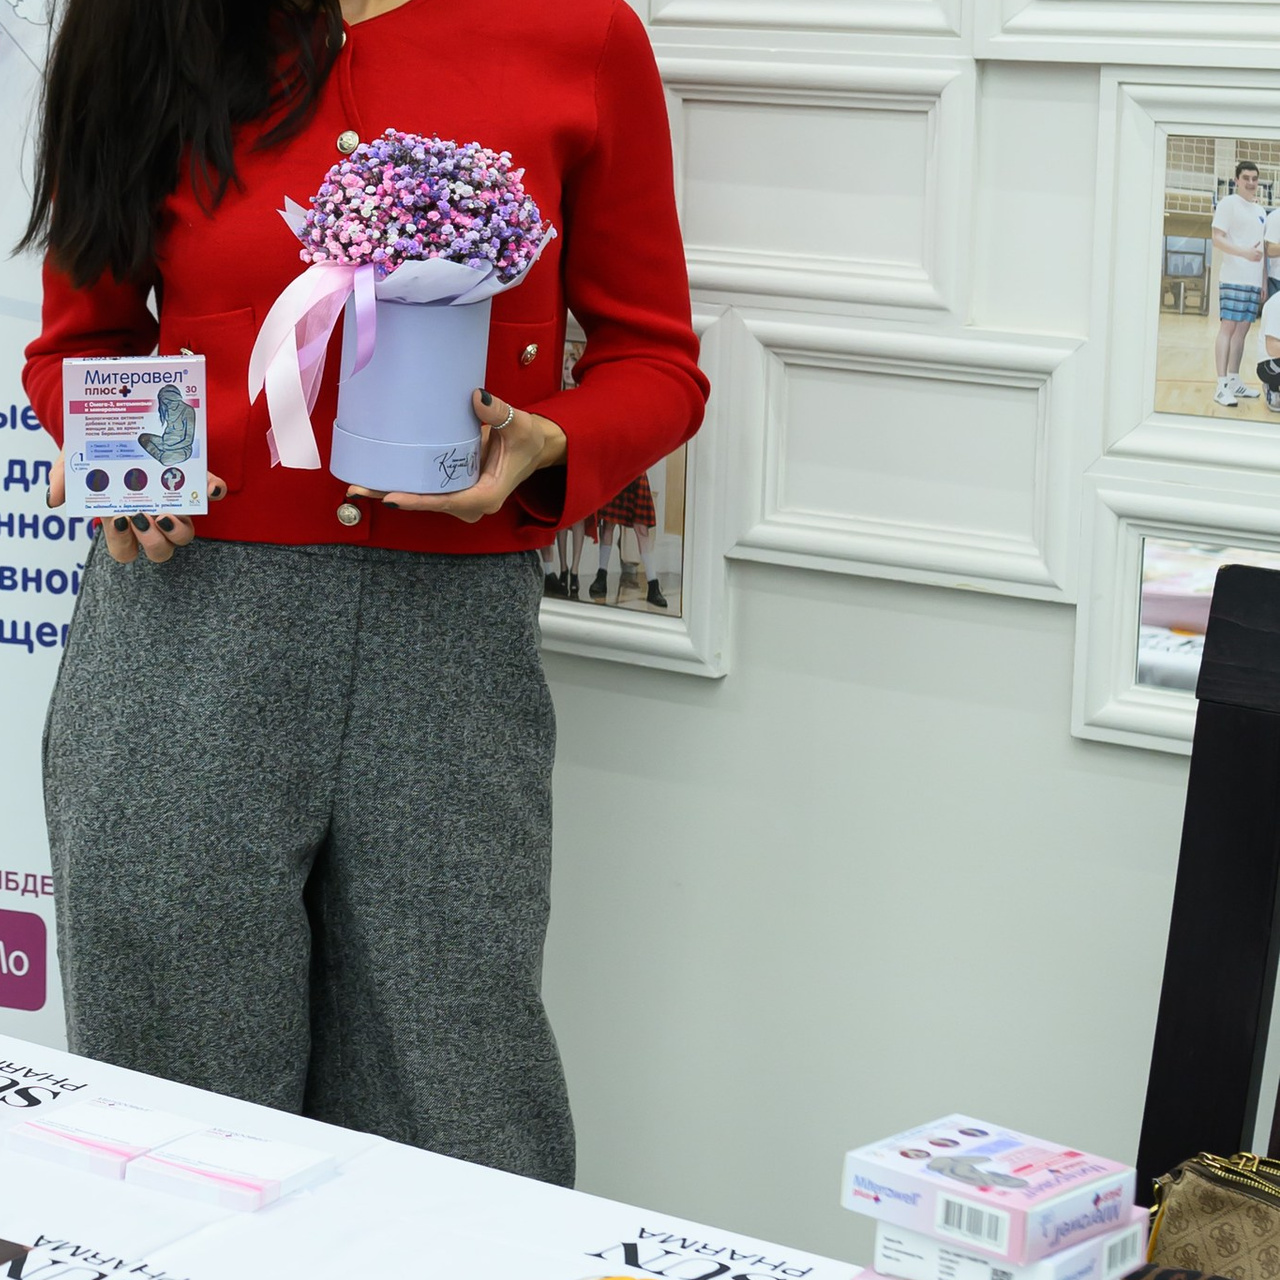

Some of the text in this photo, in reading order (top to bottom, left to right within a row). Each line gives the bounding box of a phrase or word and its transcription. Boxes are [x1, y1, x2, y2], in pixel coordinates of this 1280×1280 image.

[85, 387, 117, 396] плюс
[185, 385, 198, 394] 30
[78, 452, 84, 462] 1
[4, 459, 51, 492] дл
[638, 1227, 814, 1278] PHARMA
